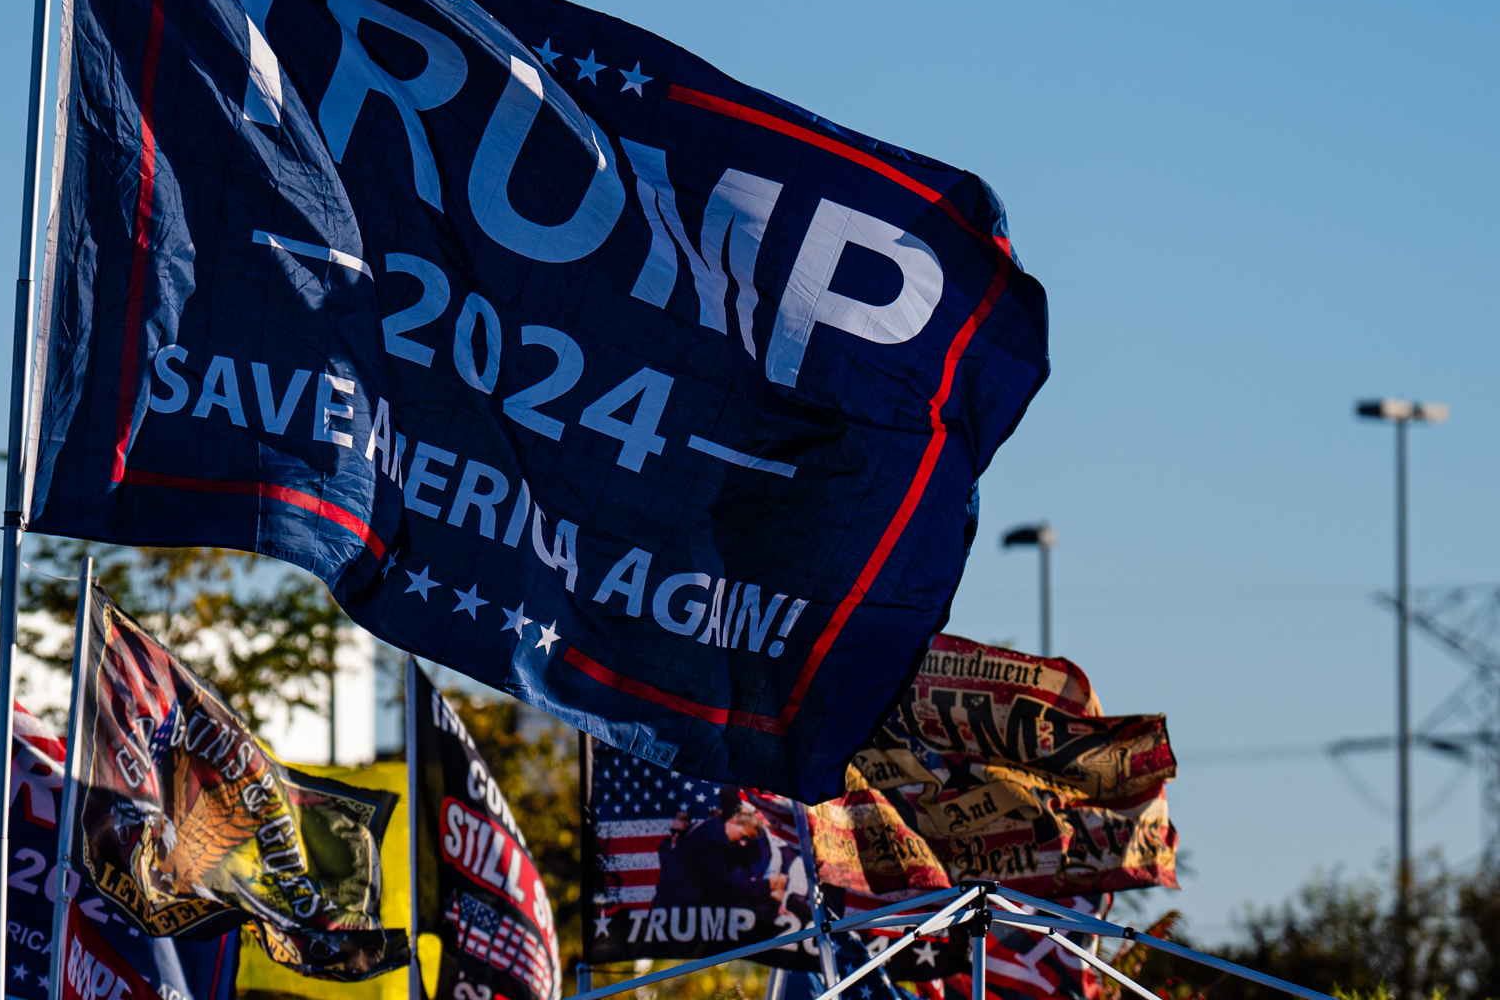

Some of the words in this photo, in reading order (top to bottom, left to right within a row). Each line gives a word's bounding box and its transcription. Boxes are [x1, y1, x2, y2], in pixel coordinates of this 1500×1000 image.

[381, 252, 675, 474] 2024
[149, 344, 356, 449] SAVE
[592, 546, 810, 658] AGAIN!
[920, 650, 1044, 687] mendment
[943, 791, 999, 833] And
[443, 802, 526, 904] STILL
[953, 834, 1041, 881] Bear
[150, 898, 211, 937] EEP
[626, 906, 757, 943] TRUMP
